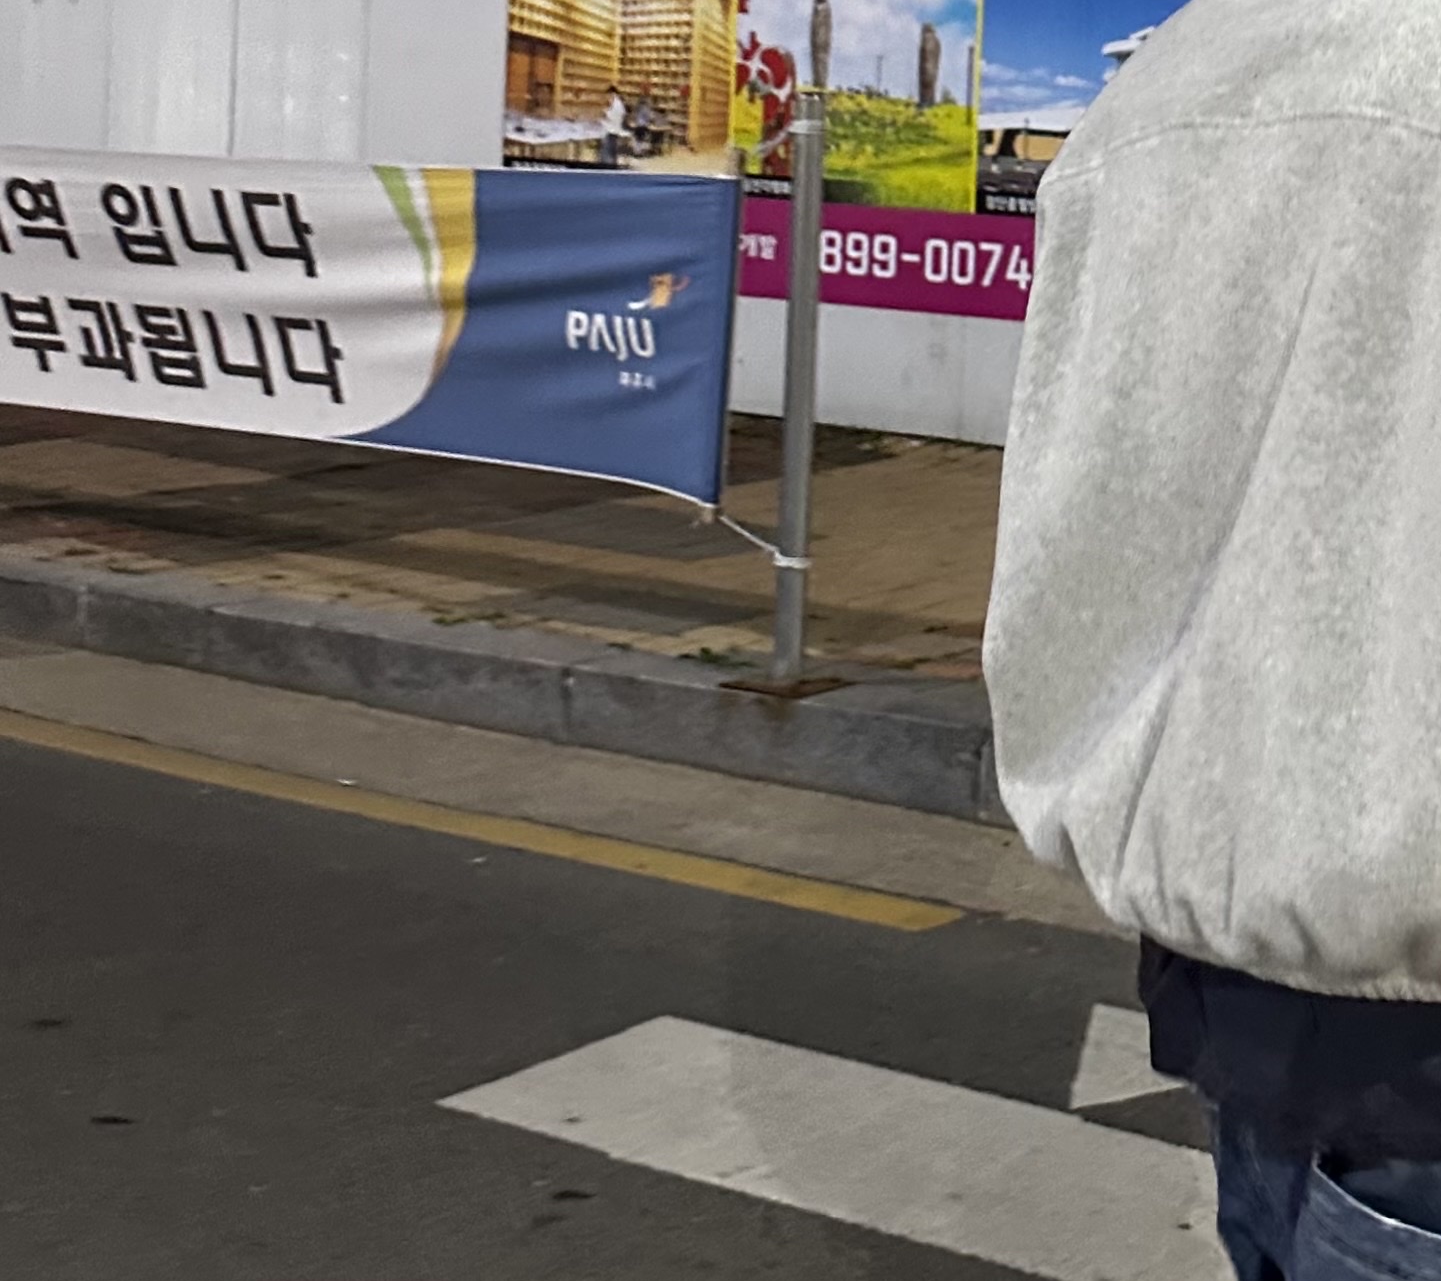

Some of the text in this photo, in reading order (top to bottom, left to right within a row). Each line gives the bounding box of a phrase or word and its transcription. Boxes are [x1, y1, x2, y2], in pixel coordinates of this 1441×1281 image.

[0, 177, 318, 277] 역 입니다
[1, 292, 345, 404] 부과됩니다
[566, 310, 656, 361] PAJU
